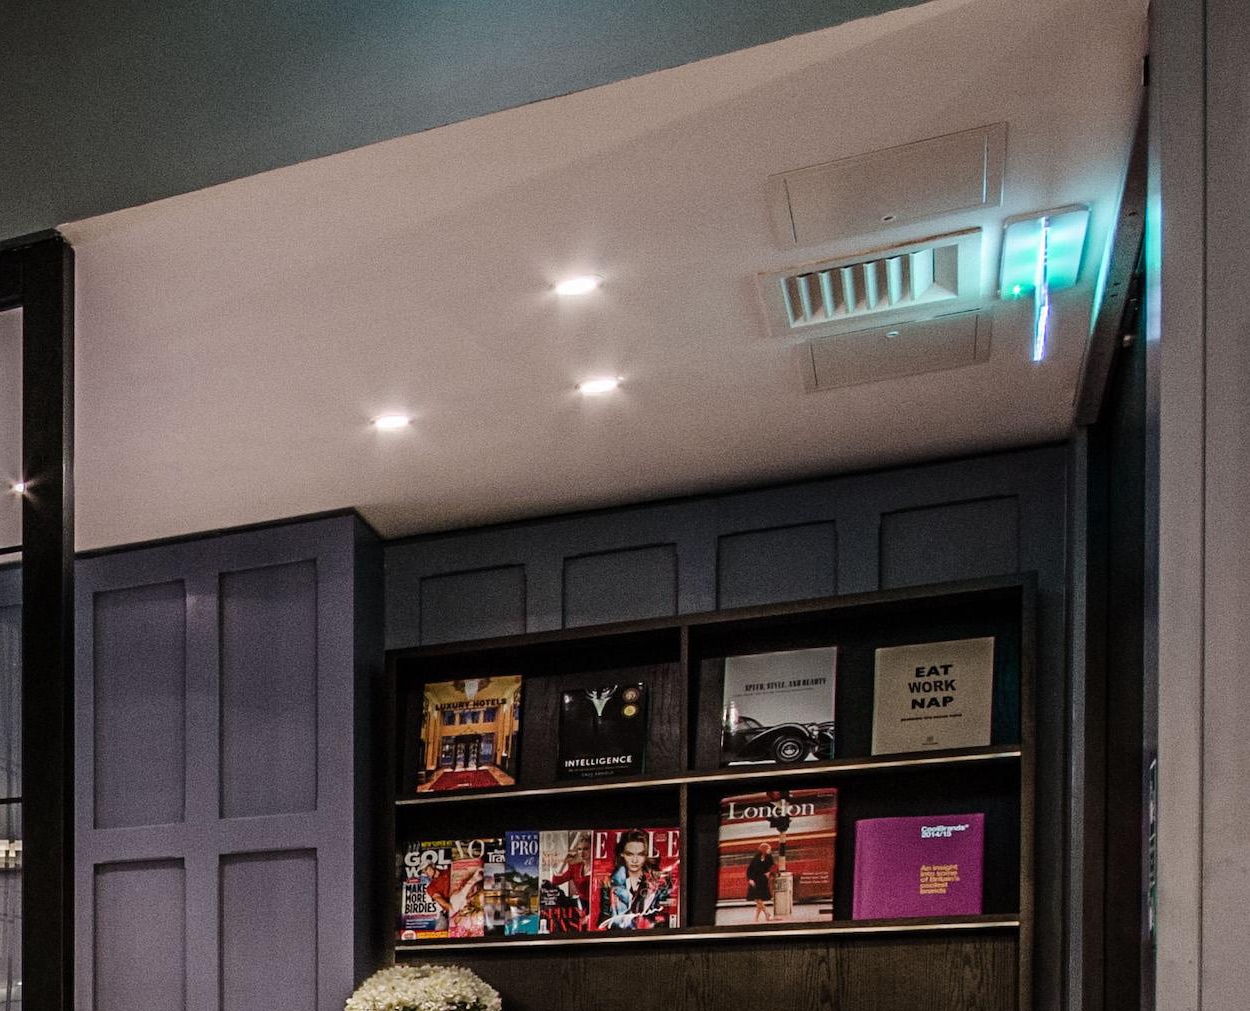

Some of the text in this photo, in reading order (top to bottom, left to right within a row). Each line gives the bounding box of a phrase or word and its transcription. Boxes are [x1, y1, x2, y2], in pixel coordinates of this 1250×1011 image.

[915, 664, 953, 678] EAT
[908, 680, 956, 693] WORK
[435, 698, 507, 711] LUXURY HOTELS
[911, 696, 954, 709] NAP
[565, 755, 633, 767] INTELLIGENCE
[728, 799, 815, 820] London
[511, 840, 538, 856] PRO
[595, 831, 680, 859] ELE
[406, 883, 427, 893] MAKE
[406, 892, 426, 903] MORE
[405, 902, 437, 914] BIRDIES
